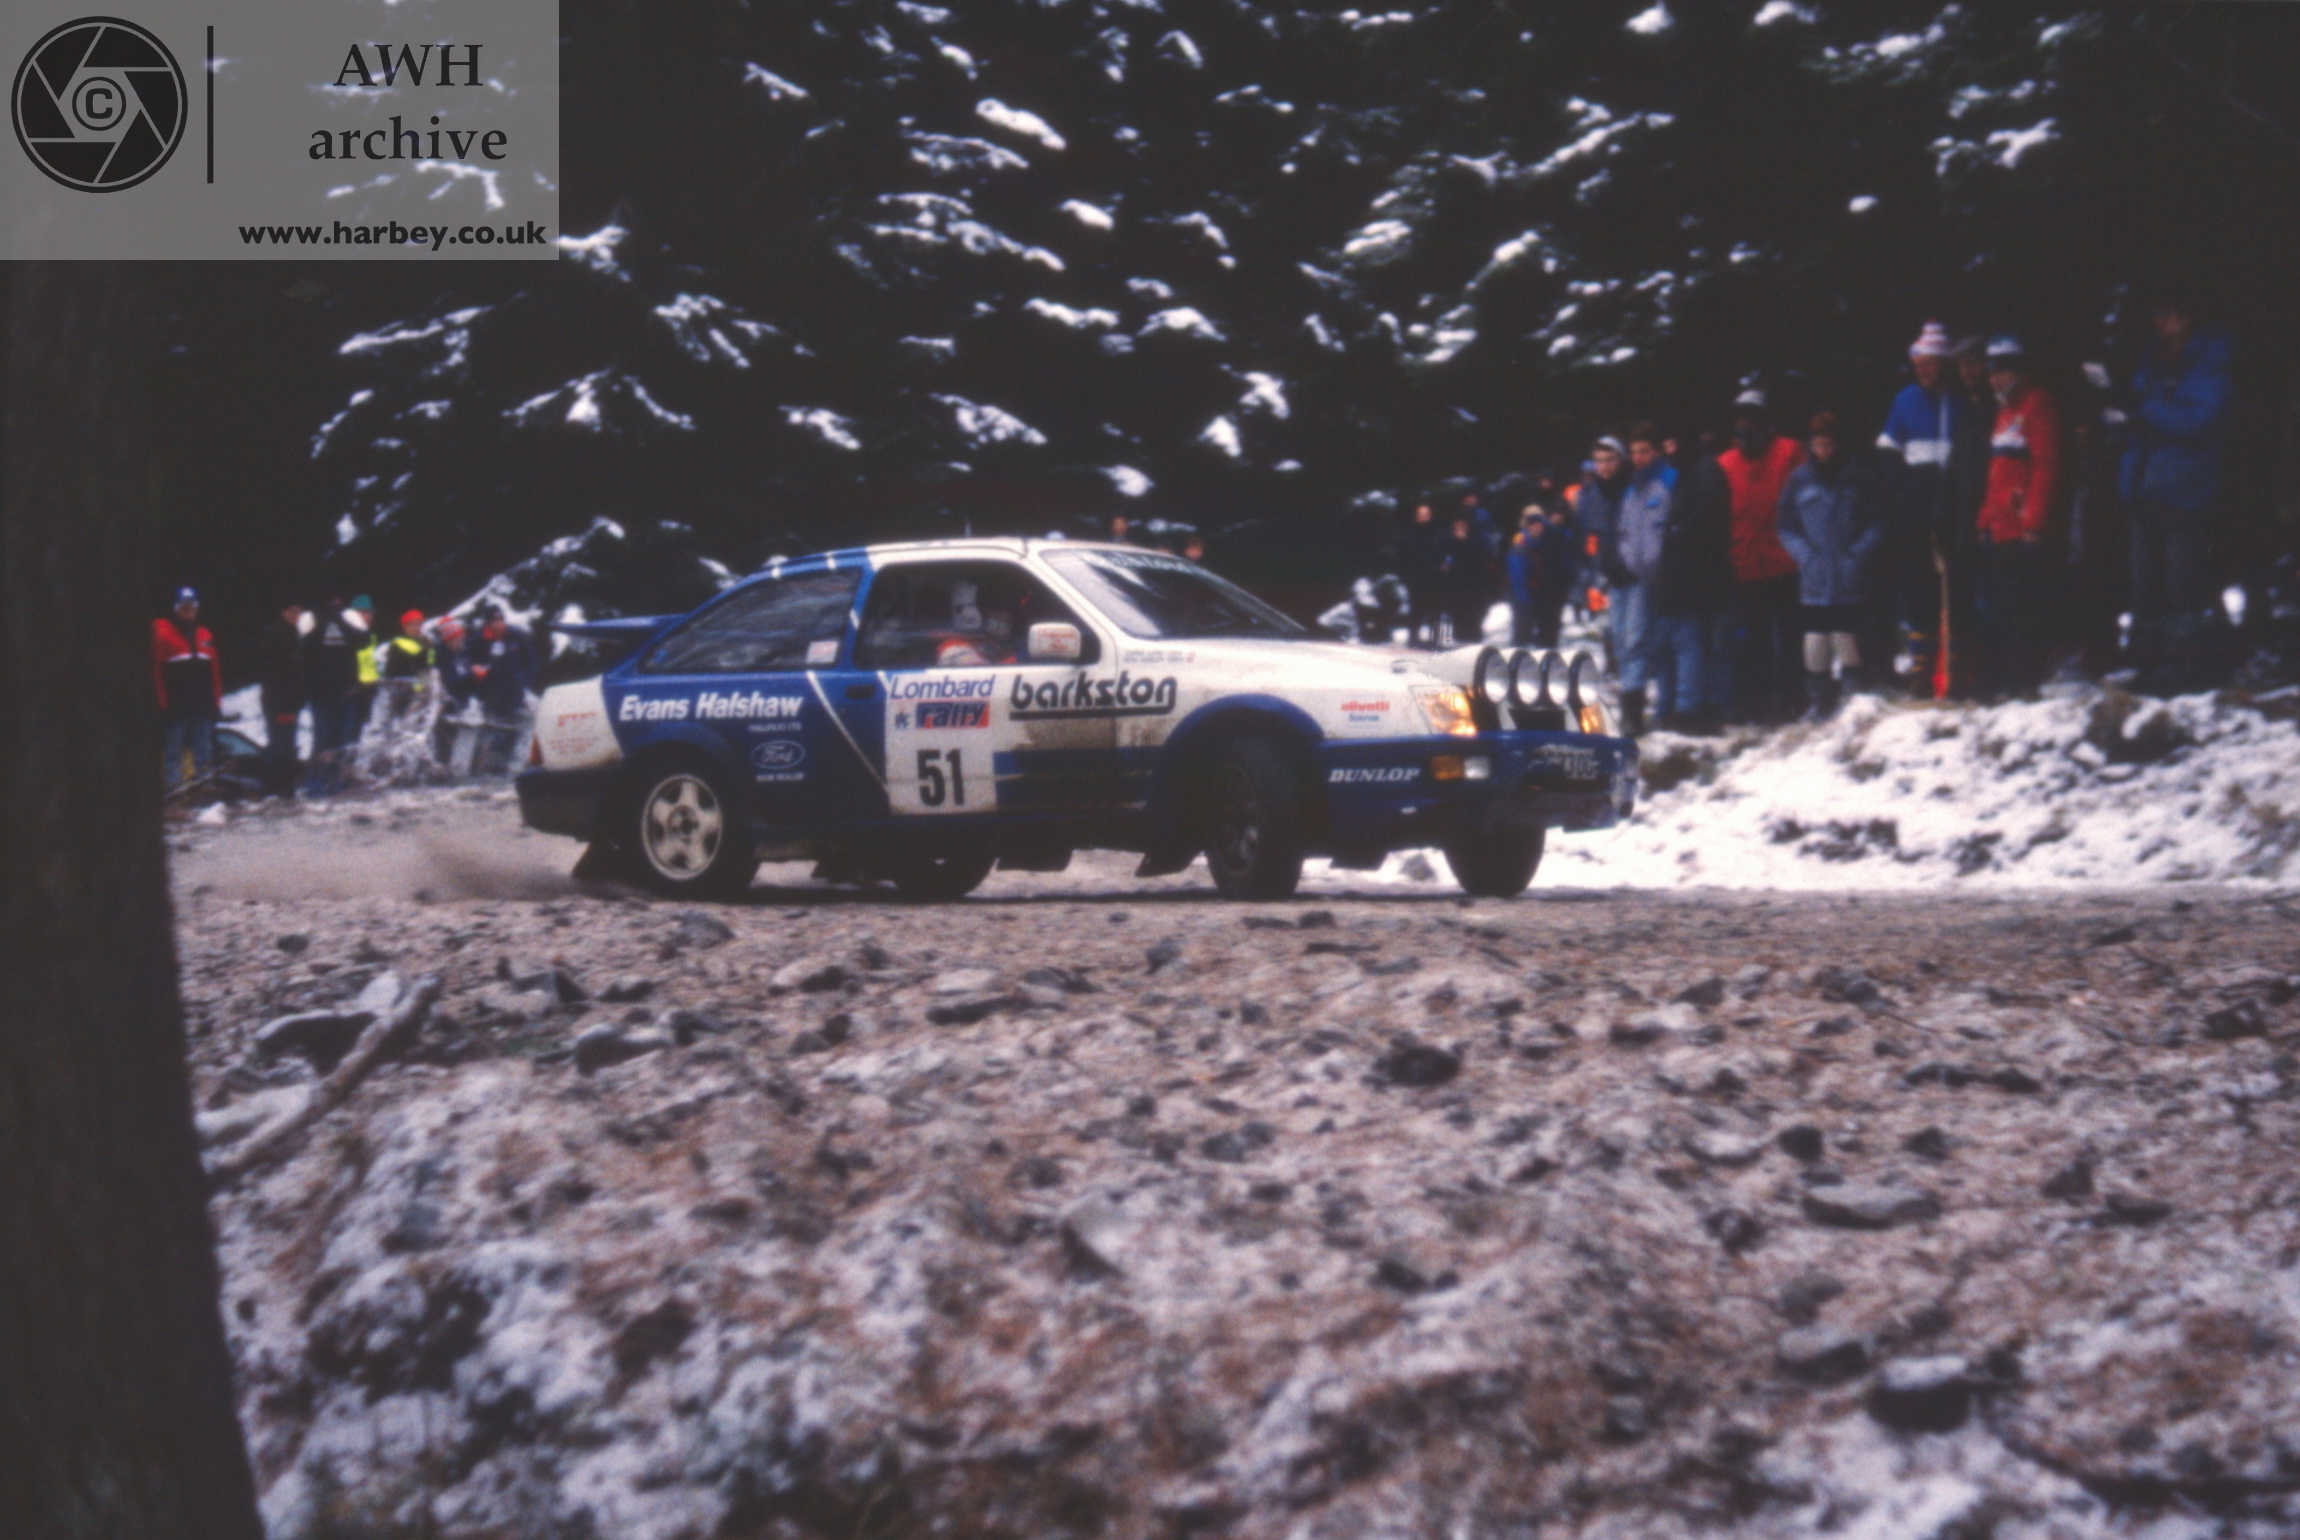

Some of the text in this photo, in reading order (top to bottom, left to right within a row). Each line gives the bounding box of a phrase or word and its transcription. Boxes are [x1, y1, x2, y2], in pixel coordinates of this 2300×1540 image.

[891, 673, 996, 701] Lombard
[1009, 671, 1178, 720] barkston
[619, 695, 690, 721] Evans
[695, 693, 803, 719] Halshaw
[917, 750, 965, 806] 51
[1328, 768, 1420, 783] DUNLOP
